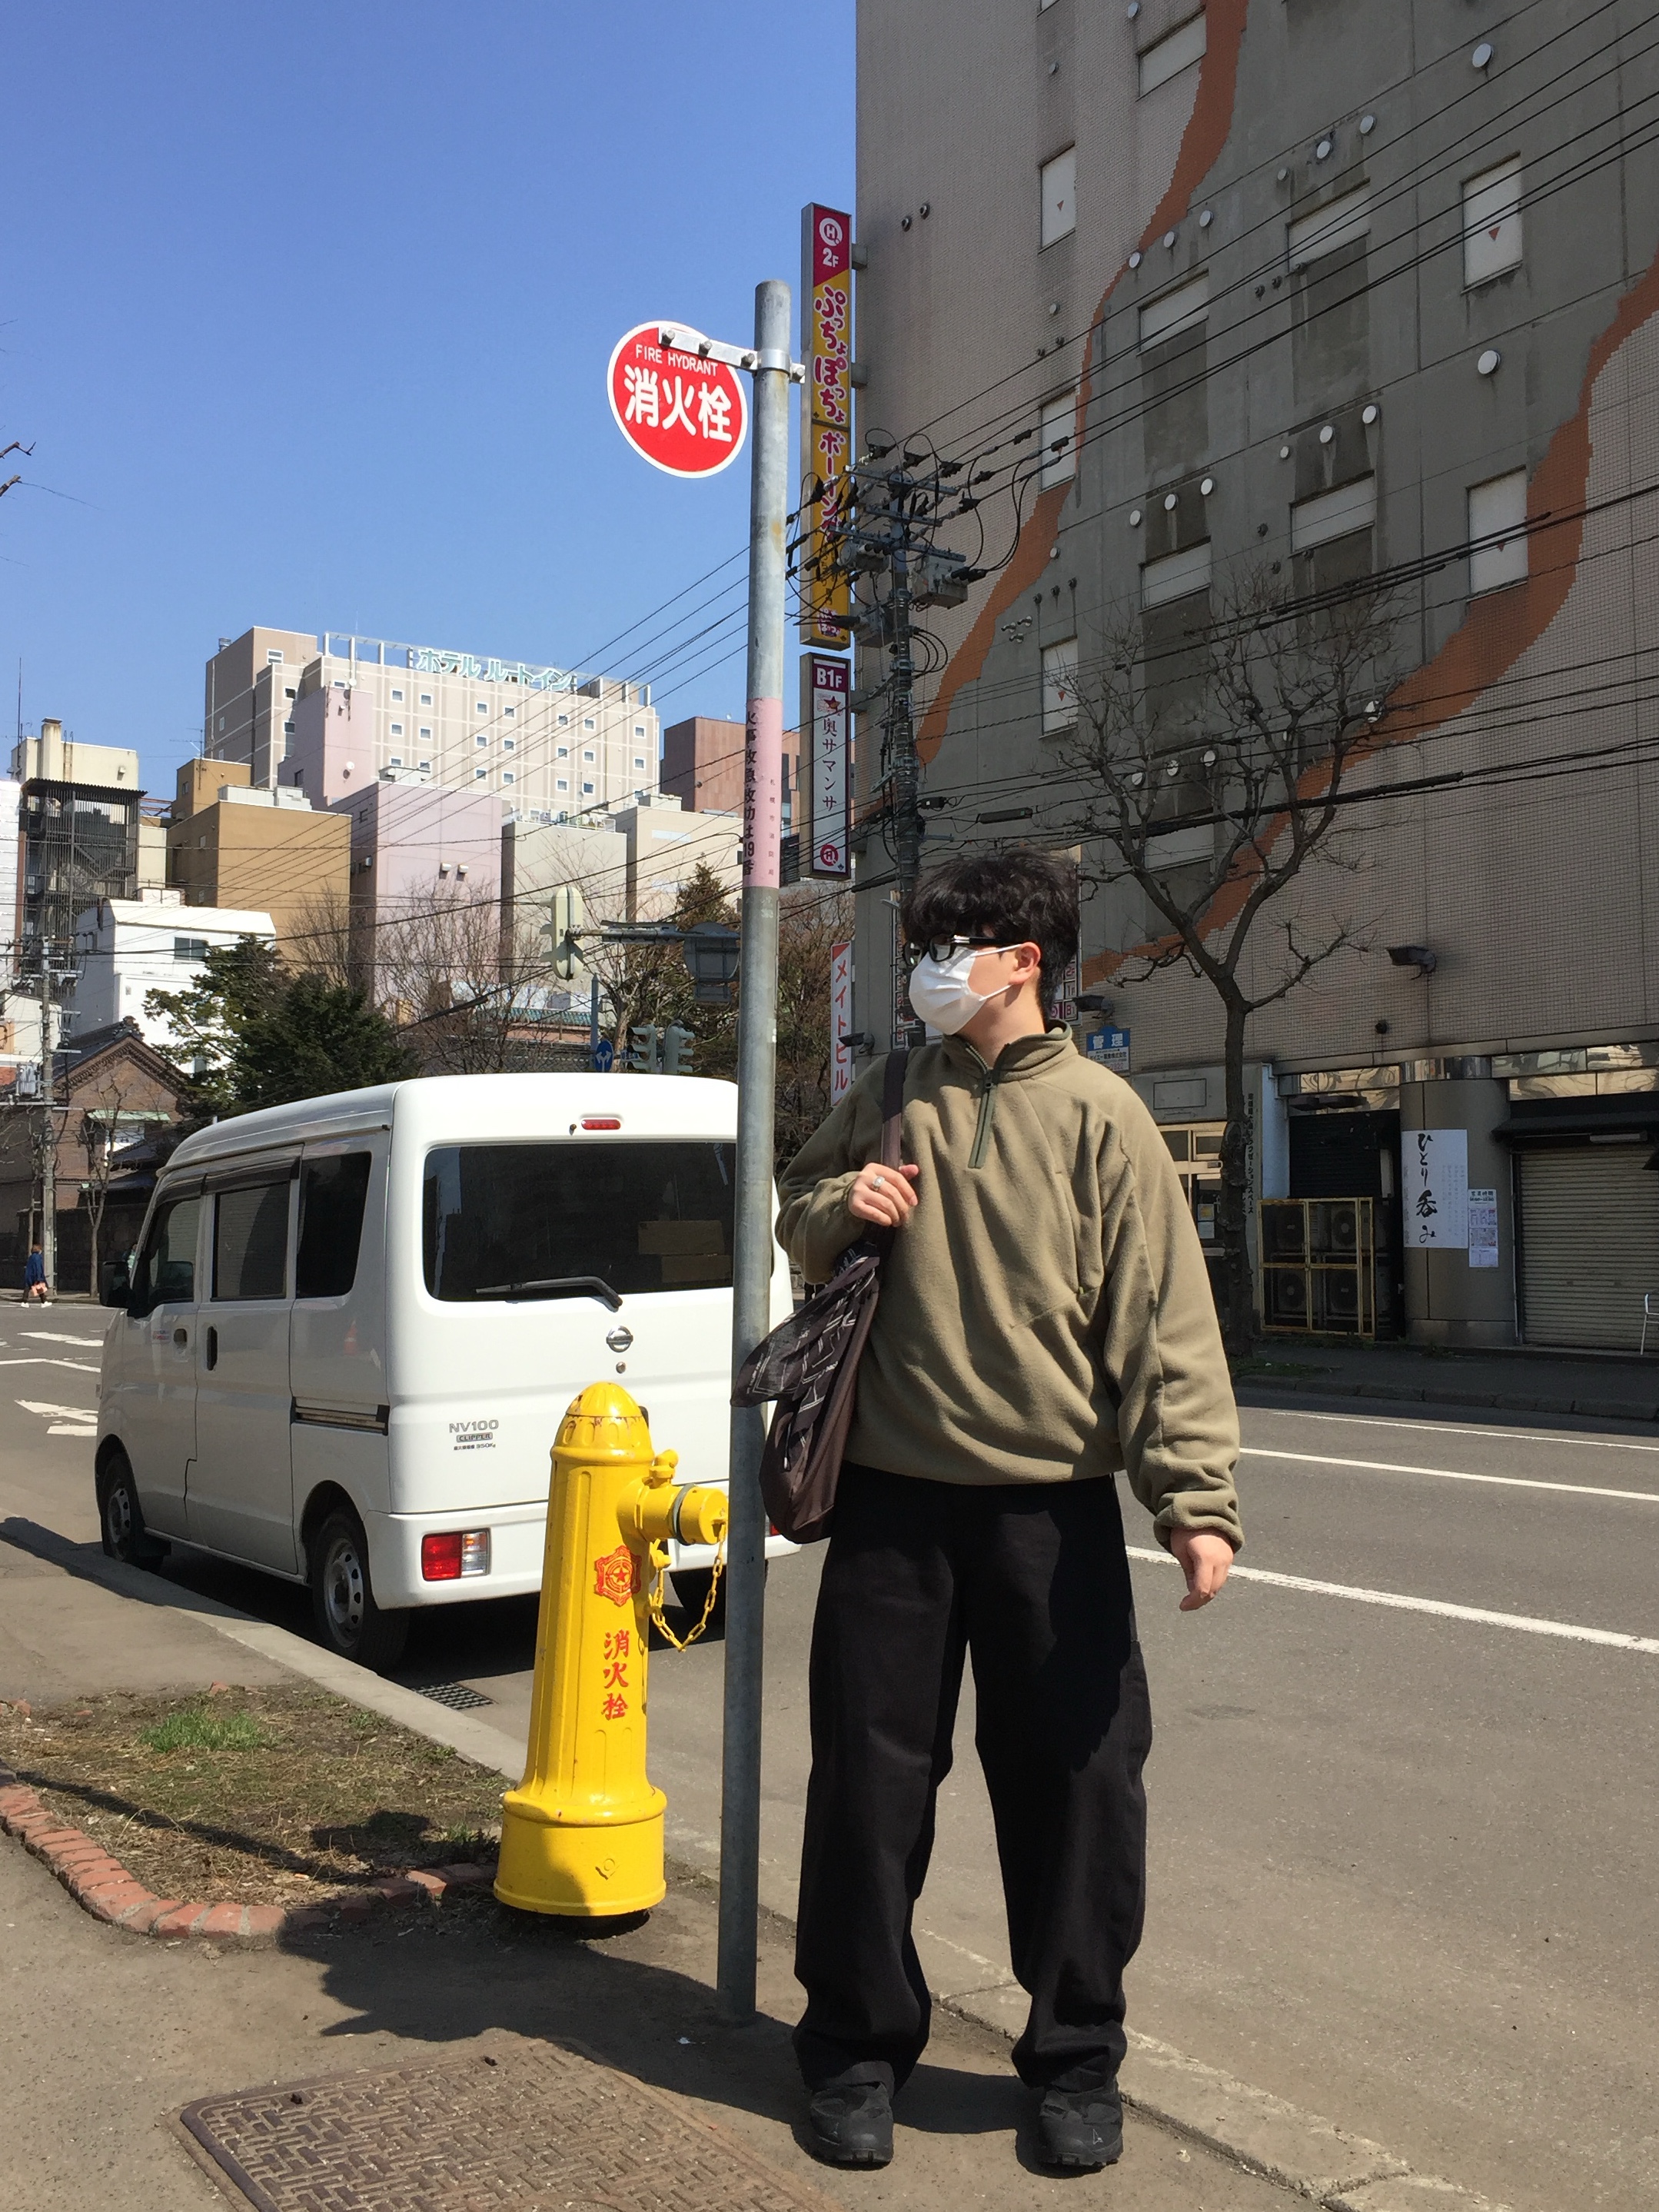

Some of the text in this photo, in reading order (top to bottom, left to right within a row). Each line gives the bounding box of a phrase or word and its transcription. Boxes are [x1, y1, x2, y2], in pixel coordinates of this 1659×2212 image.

[823, 247, 839, 268] 2F
[635, 343, 719, 377] FIRE HYDRANT
[813, 284, 849, 424] ぷっちょぽっちょ
[623, 364, 733, 443] 消火栓
[416, 648, 574, 691] ホテル ルートイン
[816, 667, 843, 690] B1F
[822, 717, 838, 812] 奥サマンサ
[835, 959, 849, 1091] メイトビル
[1092, 1033, 1124, 1050] 管理
[1416, 1133, 1438, 1244] ひとり呑み
[449, 1419, 499, 1433] NV100
[601, 1628, 630, 1721] 消火栓
